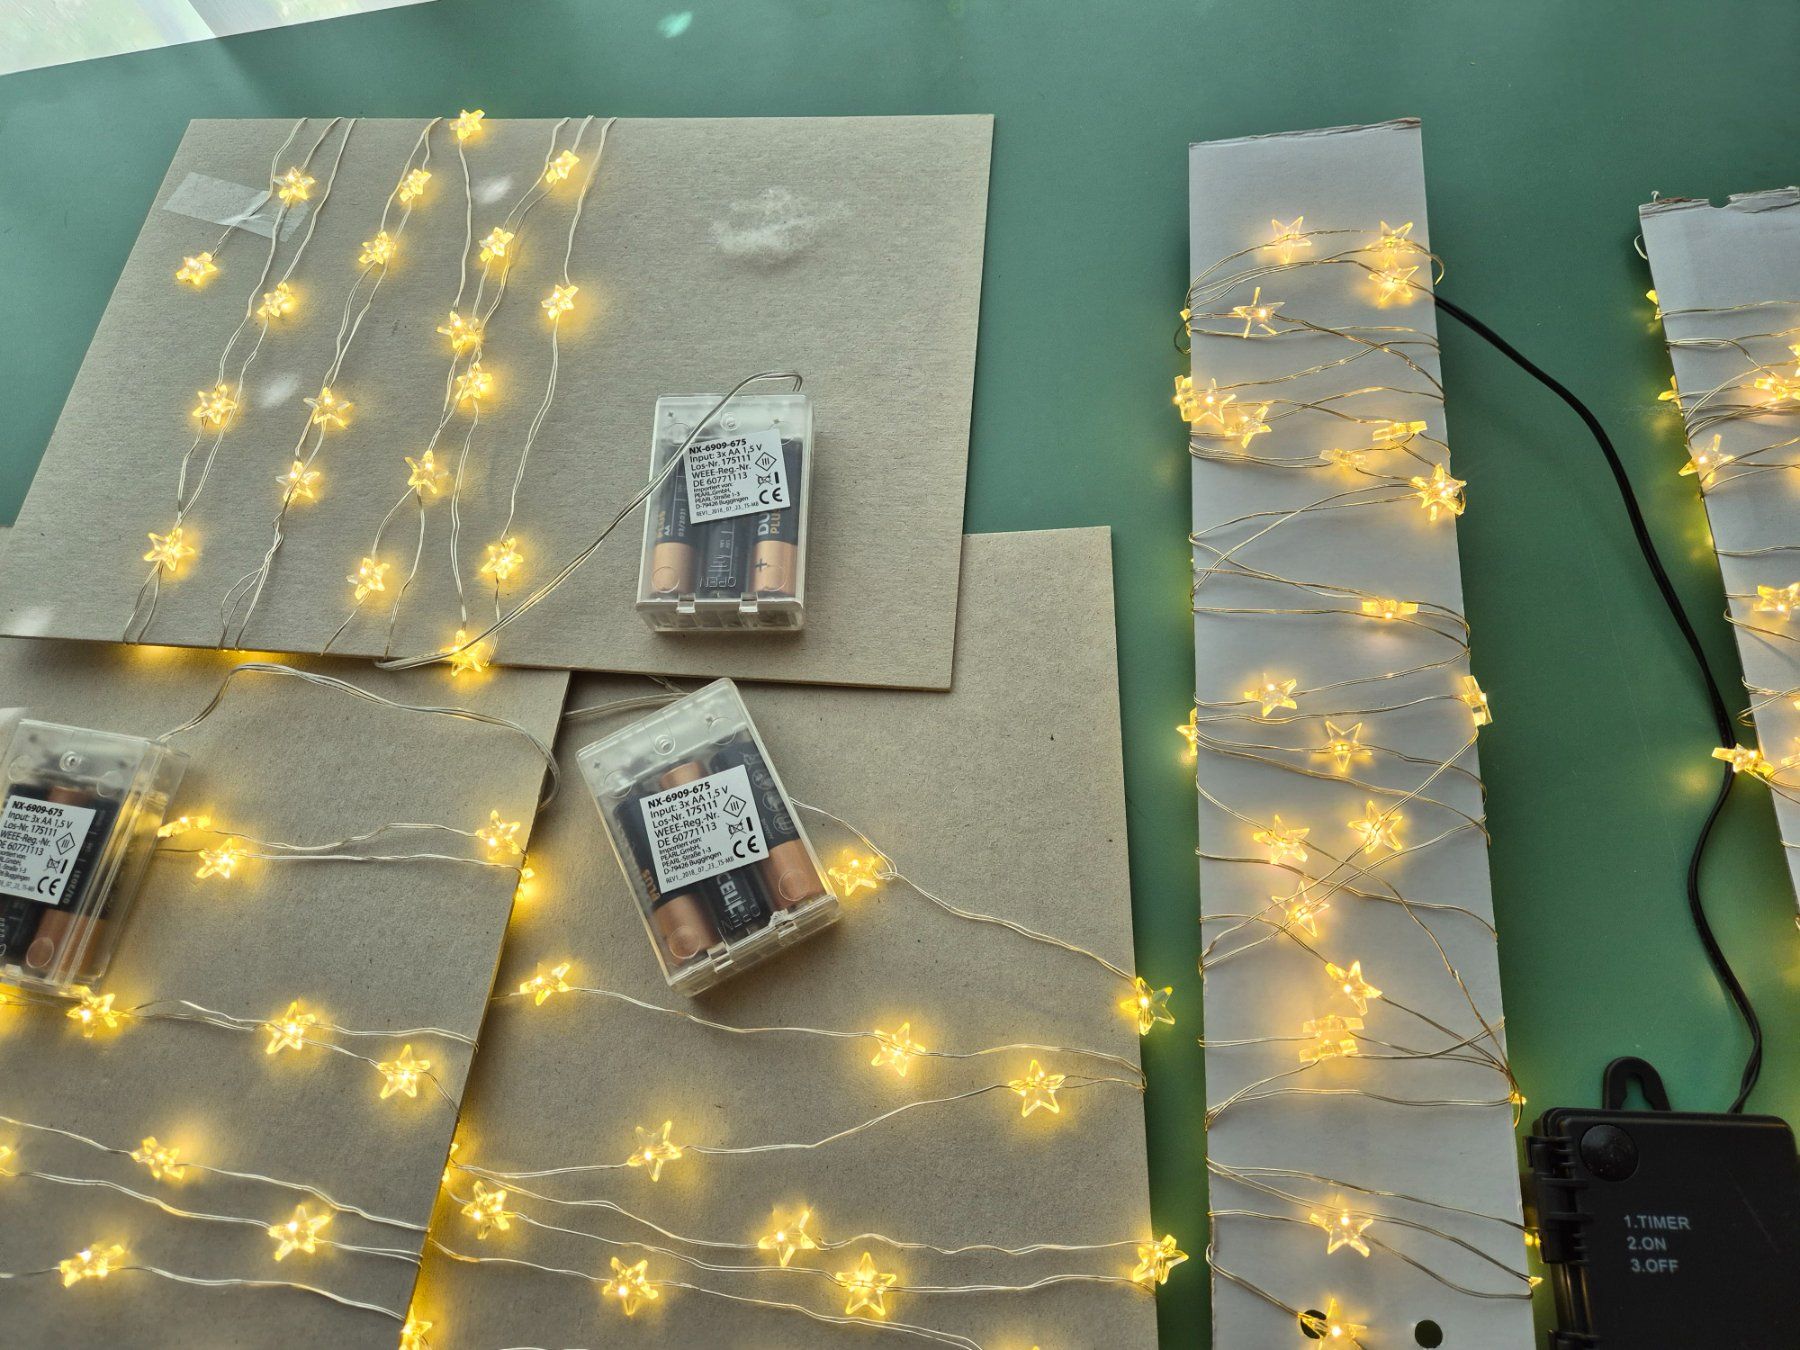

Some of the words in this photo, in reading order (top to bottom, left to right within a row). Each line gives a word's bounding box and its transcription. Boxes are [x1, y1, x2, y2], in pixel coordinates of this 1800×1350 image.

[689, 438, 747, 455] NX-6909-675
[690, 454, 715, 464] Input:
[716, 451, 726, 459] 3x
[729, 447, 741, 456] AA
[743, 445, 755, 454] 1,5
[690, 461, 719, 471] Los-Nr.
[722, 454, 751, 466] 175111
[692, 464, 752, 479] WEEE-Reg.-Nr.
[693, 477, 705, 487] DE
[707, 471, 748, 486] 60771113
[648, 781, 711, 809] NX-6909-675
[650, 804, 678, 818] Input:
[680, 798, 690, 809] 3x
[693, 793, 705, 805] AA
[707, 789, 720, 801] 1,5
[722, 785, 729, 794] V
[11, 800, 64, 816] NX-6909-675
[652, 812, 685, 828] Los-Nr.
[687, 800, 718, 817] 175111
[3, 820, 29, 833] Los-Nr.
[31, 825, 58, 837] 175111
[30, 814, 40, 823] 3x
[42, 817, 52, 826] AA
[55, 819, 65, 828] 1,5
[66, 821, 73, 829] V
[654, 811, 720, 839] WEEE-Reg.-Nr.
[0, 829, 51, 847] WEEE-Reg.-Nr.
[657, 837, 671, 848] DE
[673, 822, 717, 843] 60771113
[7, 841, 44, 856] 60771113
[689, 850, 722, 867] Buggingen
[1623, 1214, 1691, 1231] 1.TIMER
[1627, 1236, 1667, 1251] 2.ON
[1631, 1258, 1679, 1274] 3.OFF
